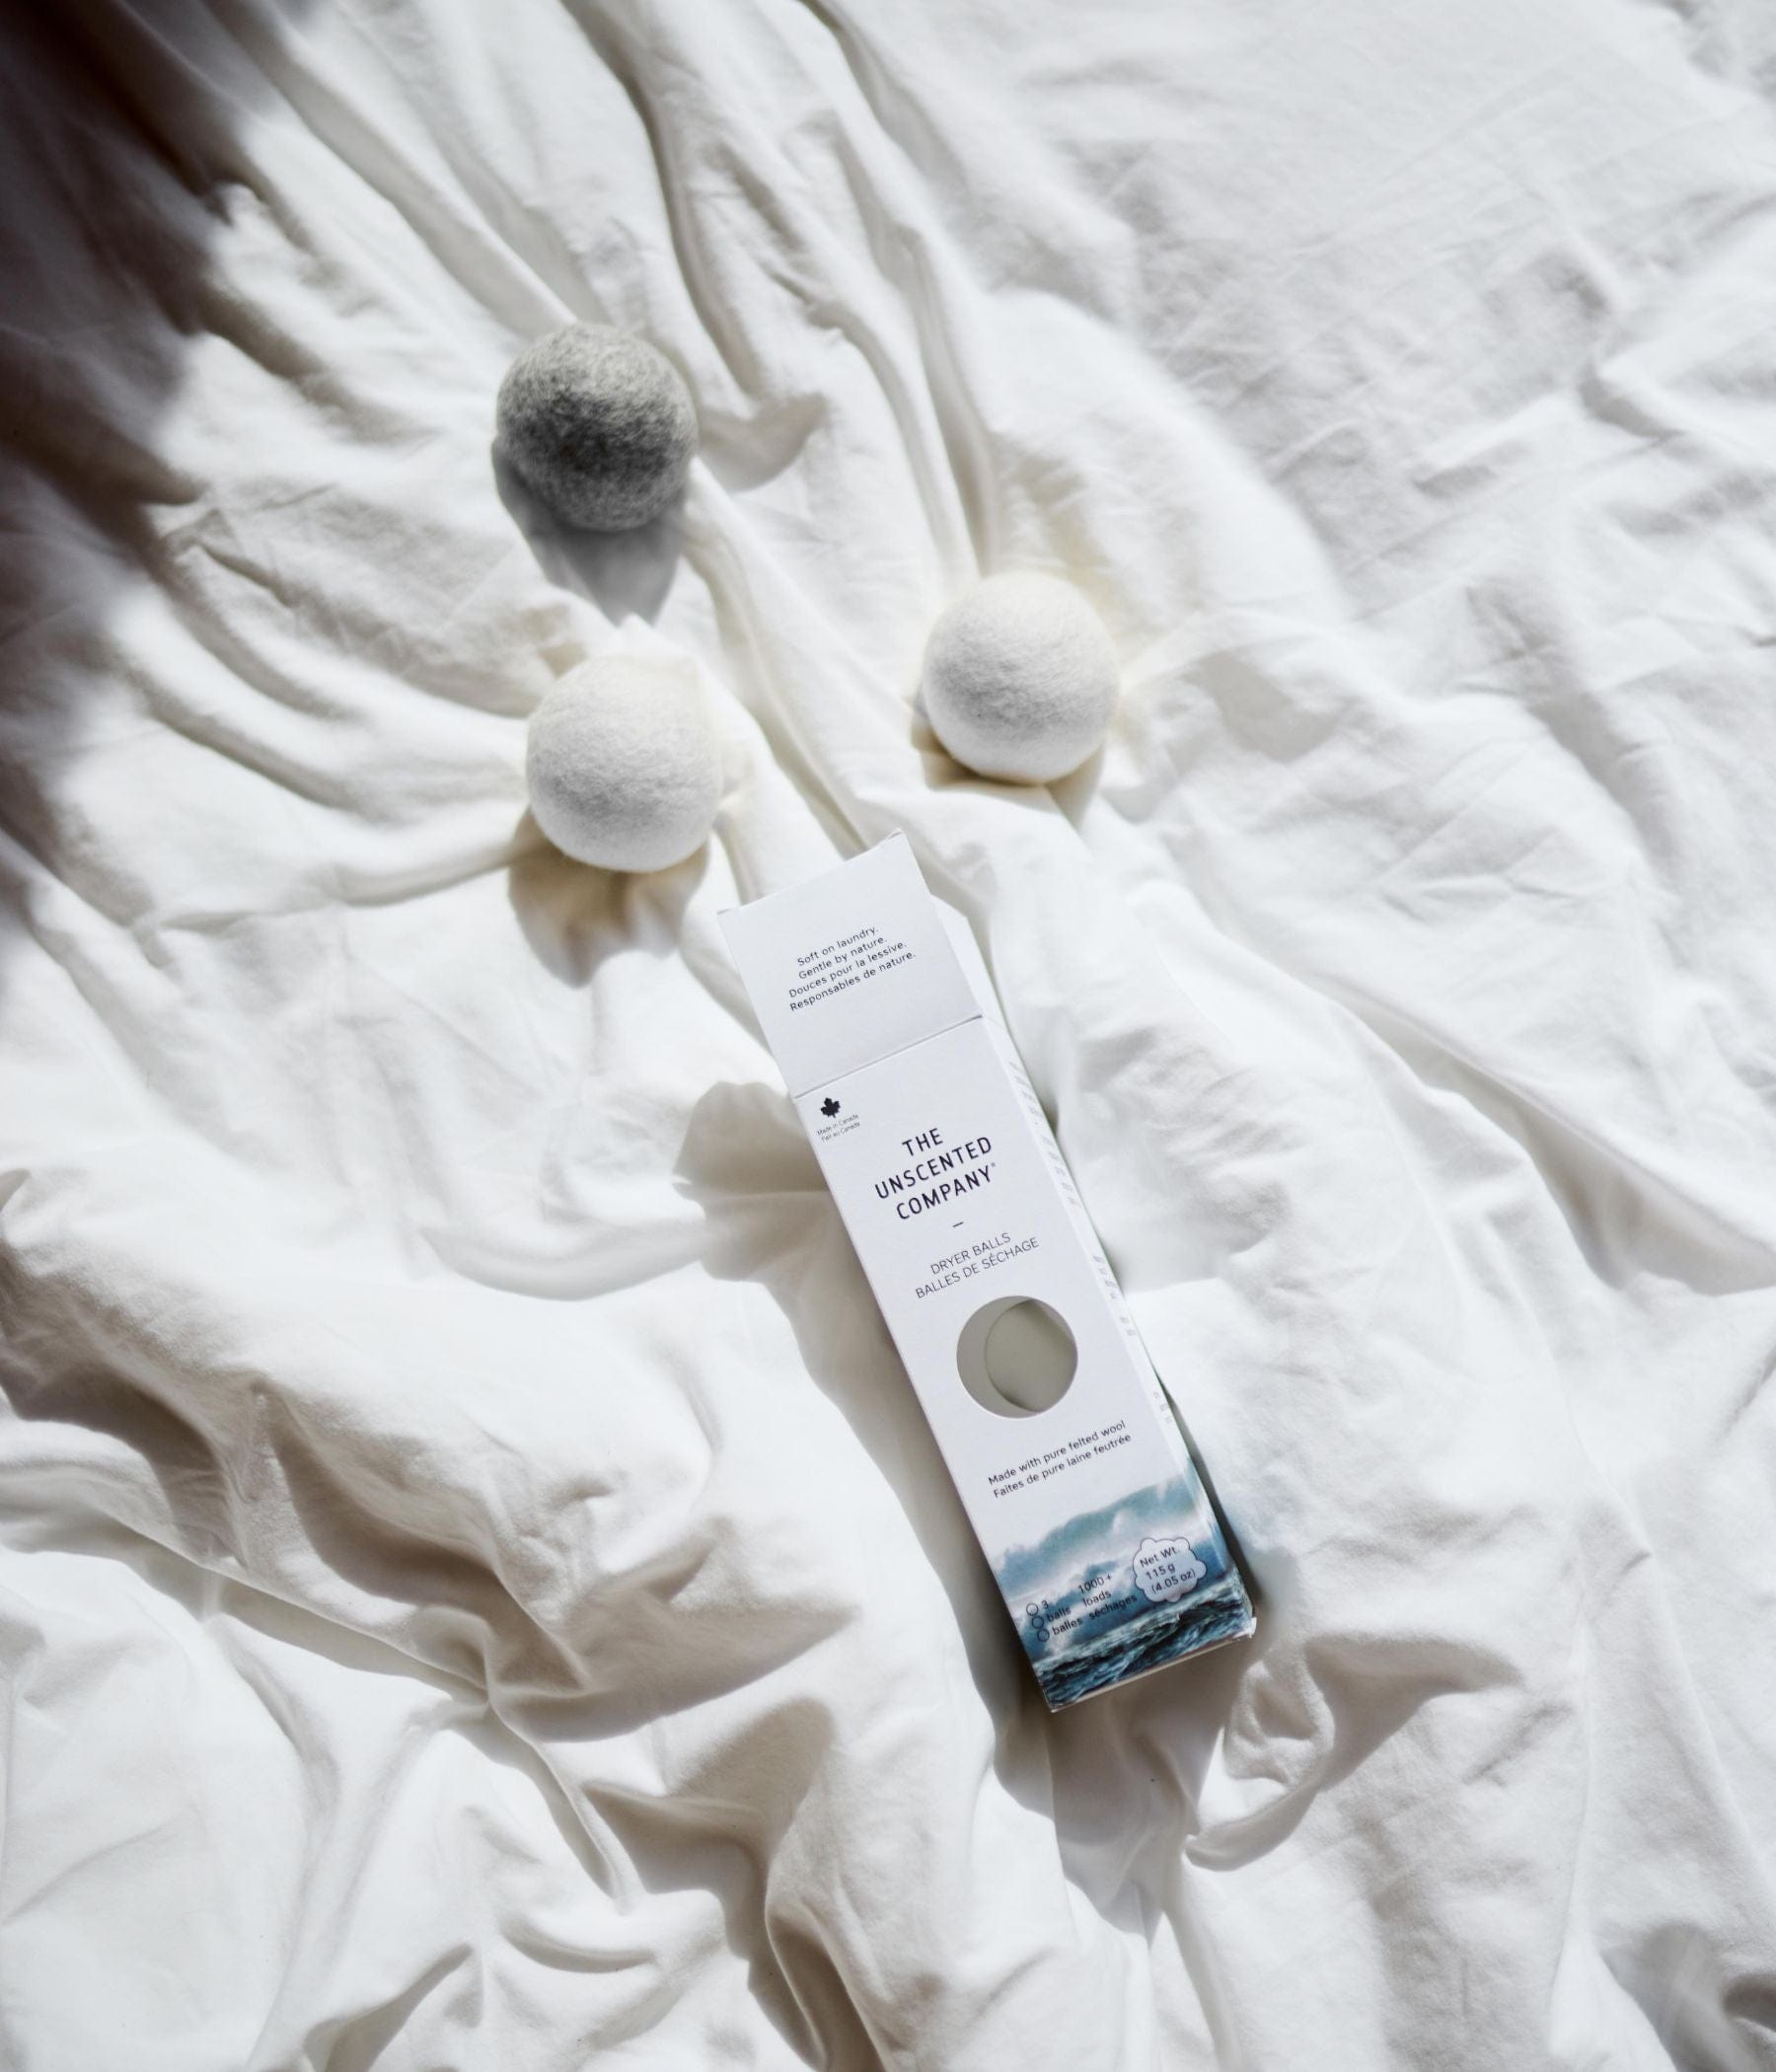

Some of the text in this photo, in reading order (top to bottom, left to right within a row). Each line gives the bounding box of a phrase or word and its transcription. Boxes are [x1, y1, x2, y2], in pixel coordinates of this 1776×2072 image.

[797, 925, 879, 966] Soft on laundry.
[798, 936, 888, 980] Gentle by nature.
[788, 940, 908, 998] Douces pour la lessive.
[789, 951, 916, 1011] Responsables de nature.
[901, 1128, 944, 1156] THE
[874, 1137, 992, 1199] UNSCENTED
[915, 1236, 1040, 1298] BALLES DE SÉCHAGE
[930, 1232, 1011, 1275] DRYER BALLS
[988, 1420, 1126, 1485] Made with pure felted wool
[993, 1434, 1132, 1498] Faites de pure laine feutrée
[1140, 1546, 1180, 1568] Net Wt.
[1146, 1563, 1176, 1580] 115 g
[1150, 1568, 1196, 1594] (4.05 oz)
[1077, 1578, 1105, 1594] 1000
[1082, 1591, 1112, 1607] loads
[1041, 1599, 1050, 1609] 3
[1046, 1605, 1072, 1622] balls
[1088, 1595, 1138, 1620] séchages
[1051, 1618, 1083, 1636] balles
